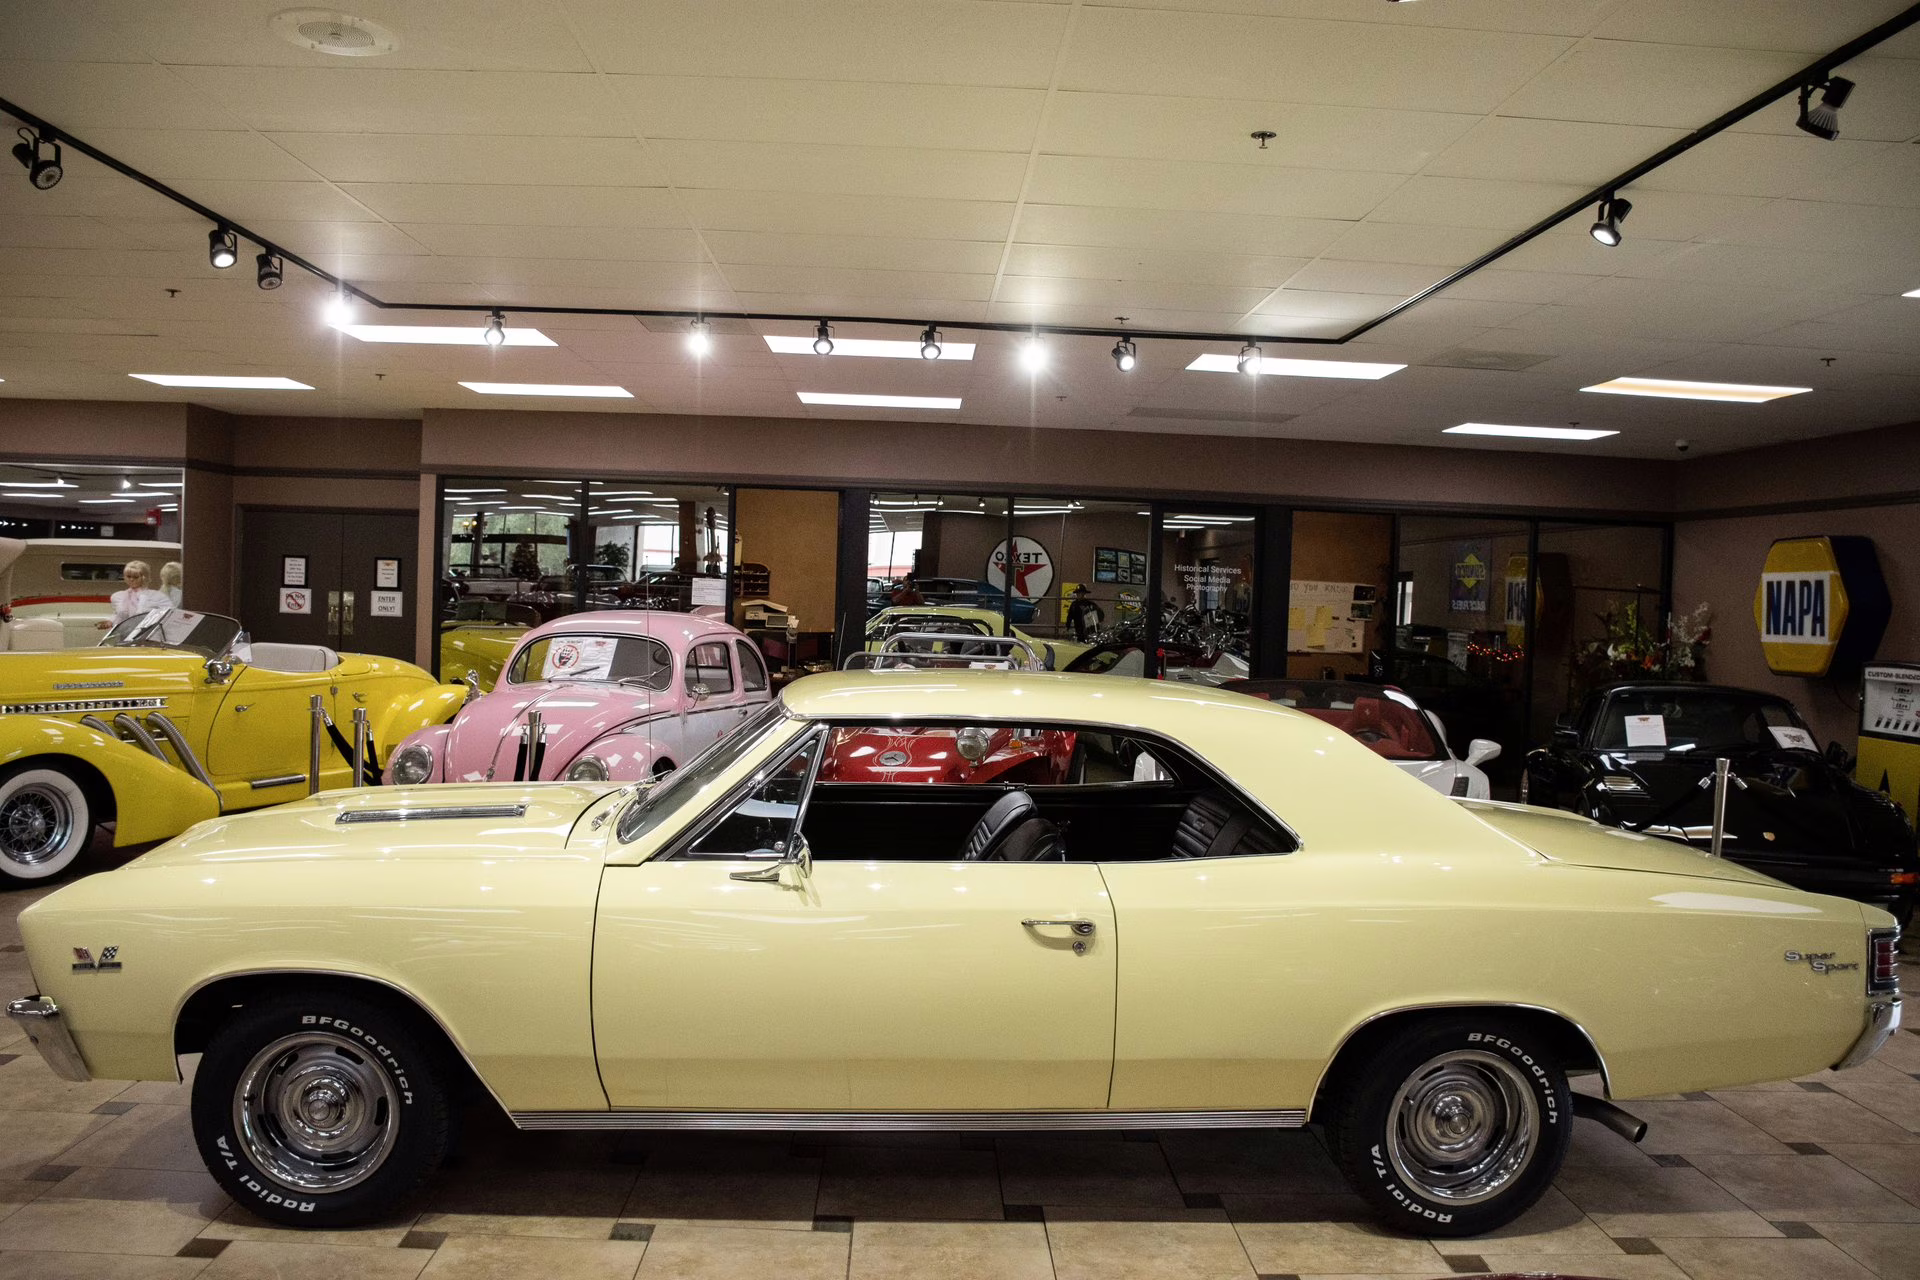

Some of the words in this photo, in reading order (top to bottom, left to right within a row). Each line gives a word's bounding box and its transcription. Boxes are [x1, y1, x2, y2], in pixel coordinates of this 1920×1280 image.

[1174, 564, 1209, 573] Historical
[1210, 566, 1242, 574] Services
[1184, 575, 1206, 583] Social
[1186, 584, 1228, 594] Photography
[1766, 580, 1826, 637] NAPA
[1783, 950, 1836, 964] Super
[1811, 961, 1859, 975] Sport
[302, 1015, 413, 1105] BFGoodrich
[1467, 1032, 1559, 1124] BFGoodrich
[216, 1135, 239, 1171] T/A
[1370, 1143, 1387, 1178] T/A
[239, 1175, 316, 1213] Radial
[1386, 1183, 1454, 1223] Radial
